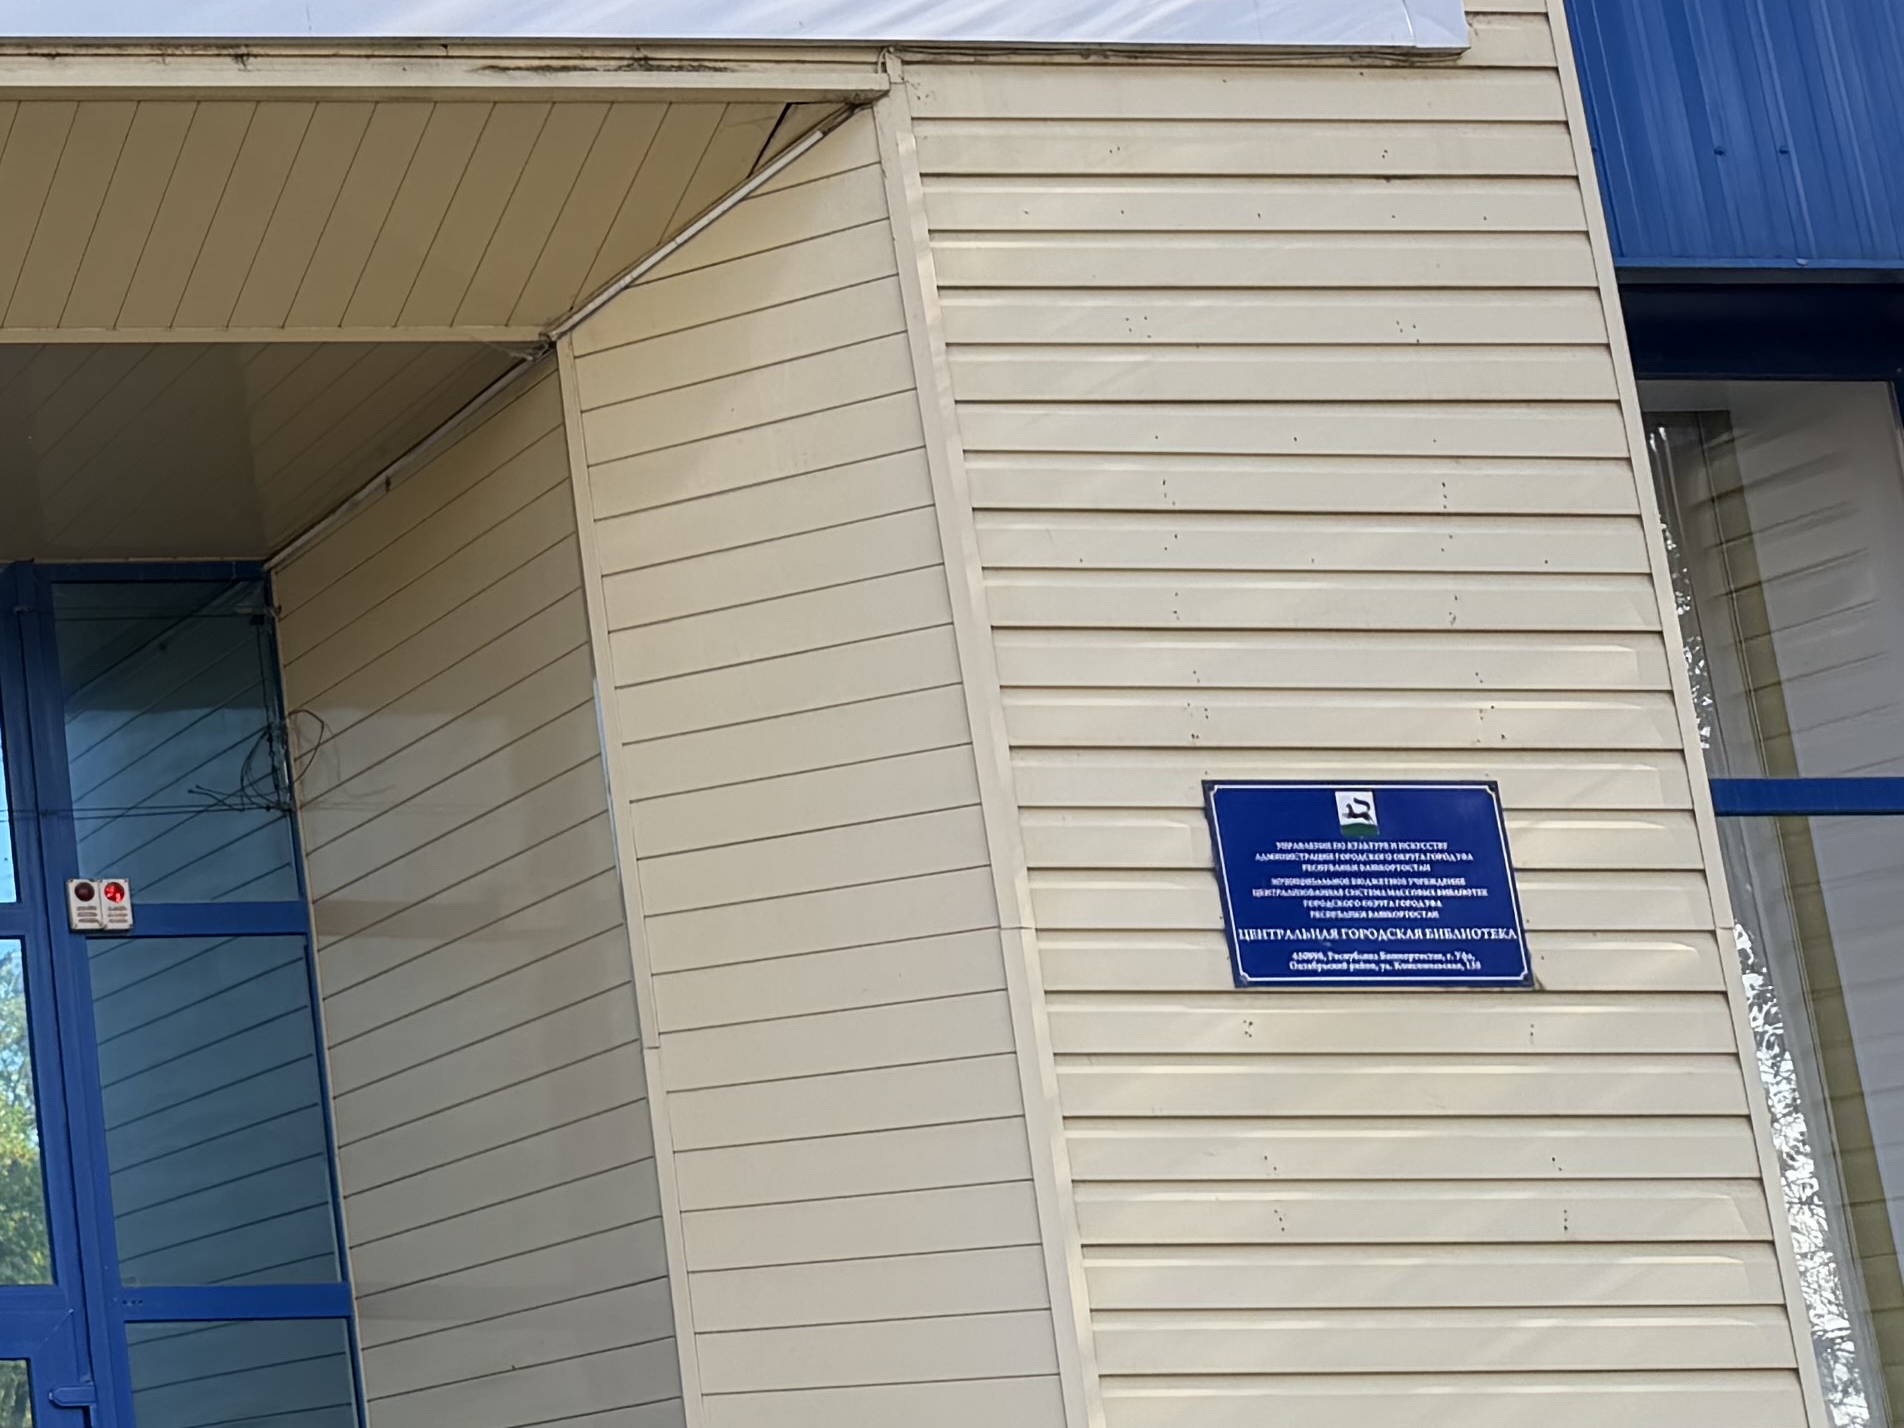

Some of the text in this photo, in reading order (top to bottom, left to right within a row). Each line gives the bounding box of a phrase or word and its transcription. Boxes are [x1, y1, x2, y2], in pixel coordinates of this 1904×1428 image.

[1238, 928, 1517, 942] ЦЕНТРАЛЬНАЯ ГОРОДСКАЯ БИБЛИОТЕКА
